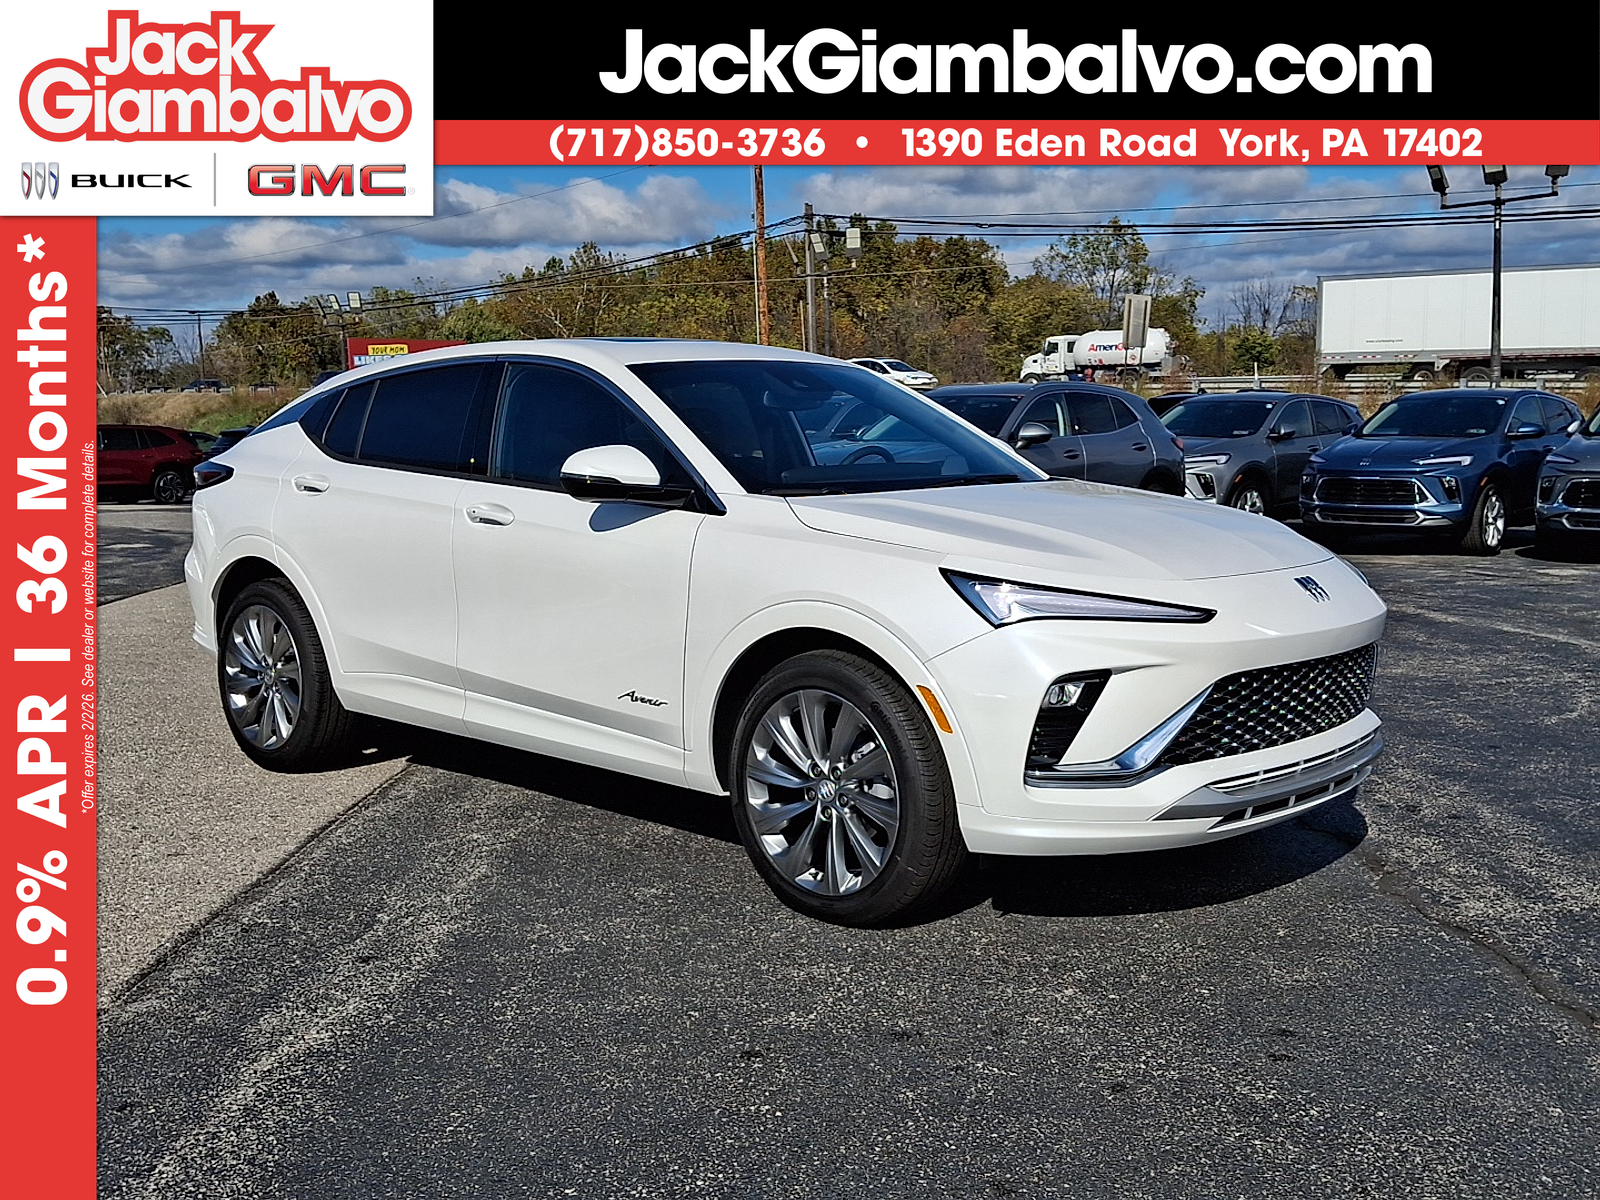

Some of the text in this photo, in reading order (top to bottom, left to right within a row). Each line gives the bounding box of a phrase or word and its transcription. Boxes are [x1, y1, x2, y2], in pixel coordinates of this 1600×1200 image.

[371, 346, 405, 355] YOUR MOM
[1088, 342, 1135, 352] AmeriG
